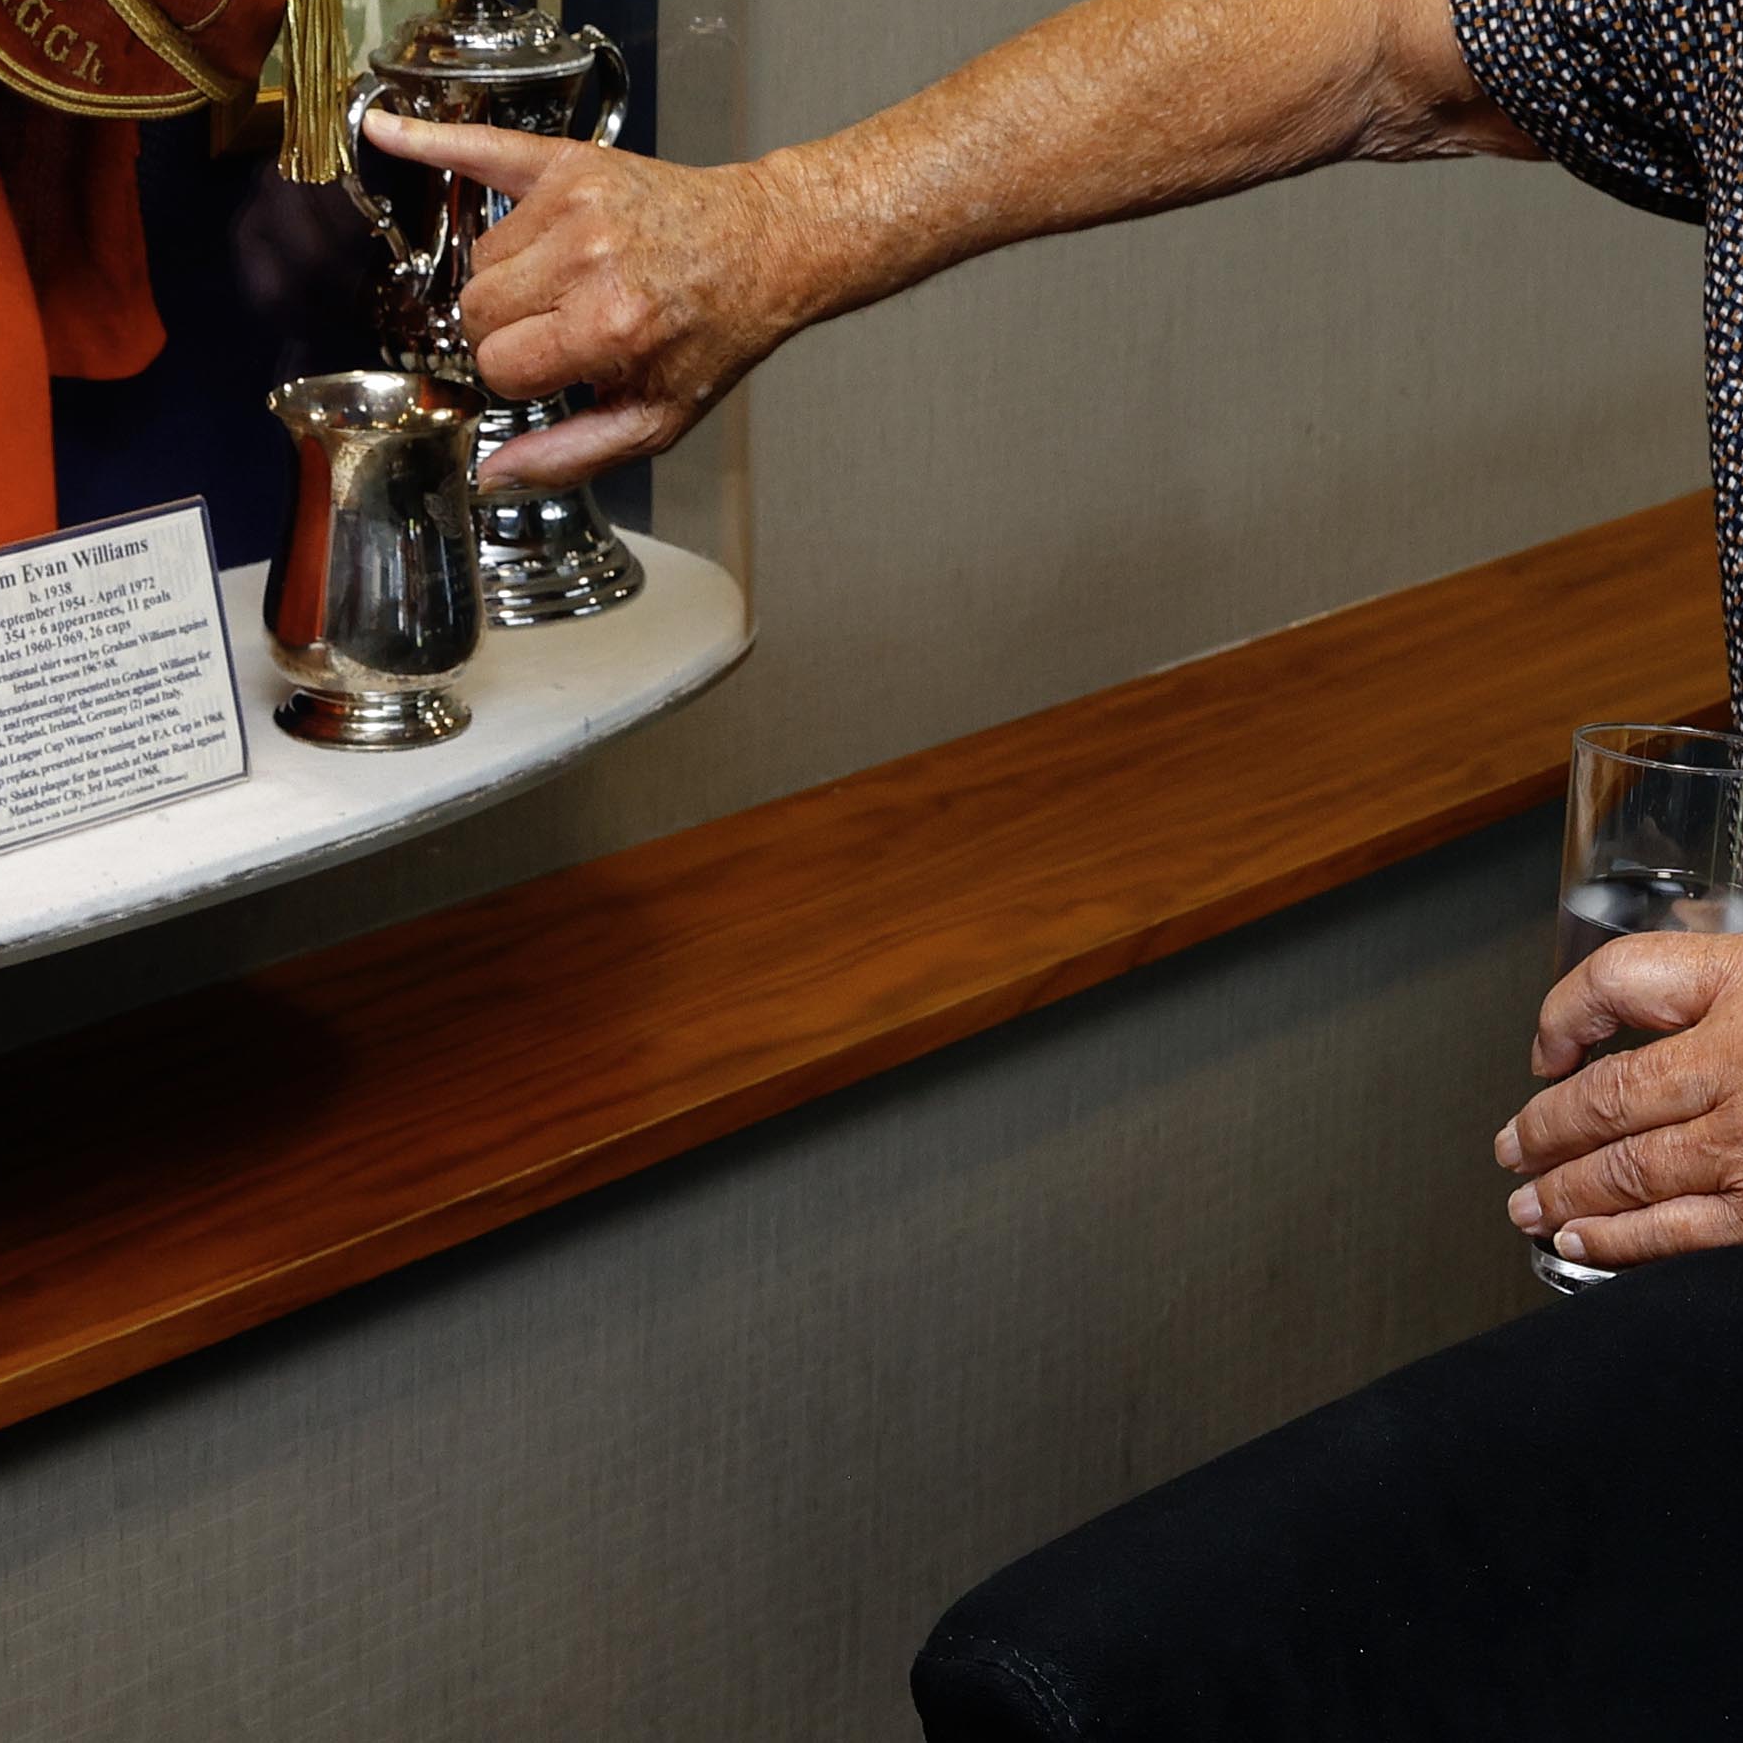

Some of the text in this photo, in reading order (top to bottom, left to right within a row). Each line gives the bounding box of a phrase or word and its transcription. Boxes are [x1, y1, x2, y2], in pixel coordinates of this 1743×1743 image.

[21, 560, 67, 582] Evan
[72, 539, 147, 567] Williams
[4, 628, 25, 644] 354
[39, 622, 47, 634] 6
[50, 606, 124, 633] appearances,
[126, 597, 138, 611] 11
[142, 590, 171, 609] goals
[28, 581, 72, 603] b. 1938
[59, 595, 85, 612] 1954
[97, 584, 126, 603] April
[129, 576, 155, 594] 1972
[25, 630, 87, 656] 1960-1969,
[89, 625, 103, 639] 26
[105, 620, 130, 634] caps
[39, 658, 60, 671] shirt
[63, 653, 87, 664] worn
[88, 649, 99, 658] by
[101, 639, 137, 654] Graham
[138, 628, 176, 643] Williams
[178, 618, 208, 634] against
[12, 676, 48, 694] Ireland,
[49, 670, 79, 683] season
[48, 692, 65, 703] cap
[66, 678, 110, 700] presented
[111, 677, 120, 685] to
[121, 667, 158, 682] Graham
[159, 655, 196, 670] Williams
[197, 650, 210, 660] for
[2, 717, 20, 731] and
[21, 704, 77, 726] representing
[78, 698, 92, 709] the
[95, 689, 130, 705] matches
[132, 679, 161, 695] against
[7, 726, 47, 745] England,
[48, 715, 85, 733] Ireland,
[85, 705, 127, 722] Germany
[129, 698, 142, 710] (2)
[143, 693, 160, 706] and
[161, 688, 183, 700] Italy.
[9, 748, 42, 764] League
[43, 741, 64, 753] Cup
[108, 716, 143, 734] tankard
[10, 785, 38, 800] Shield
[40, 778, 70, 795] plaque
[71, 773, 85, 783] for
[86, 768, 100, 779] the
[102, 758, 130, 774] match
[132, 756, 140, 765] at
[141, 748, 169, 760] Maine
[171, 738, 194, 753] Road
[196, 730, 226, 746] against
[40, 753, 83, 776] presented
[85, 750, 98, 760] for
[100, 739, 136, 755] winning
[137, 734, 150, 745] the
[152, 728, 170, 741] F.A.
[172, 722, 192, 734] Cup
[193, 720, 201, 728] in
[8, 795, 60, 816] Manchester
[87, 780, 102, 793] 3rd
[105, 772, 135, 788] August
